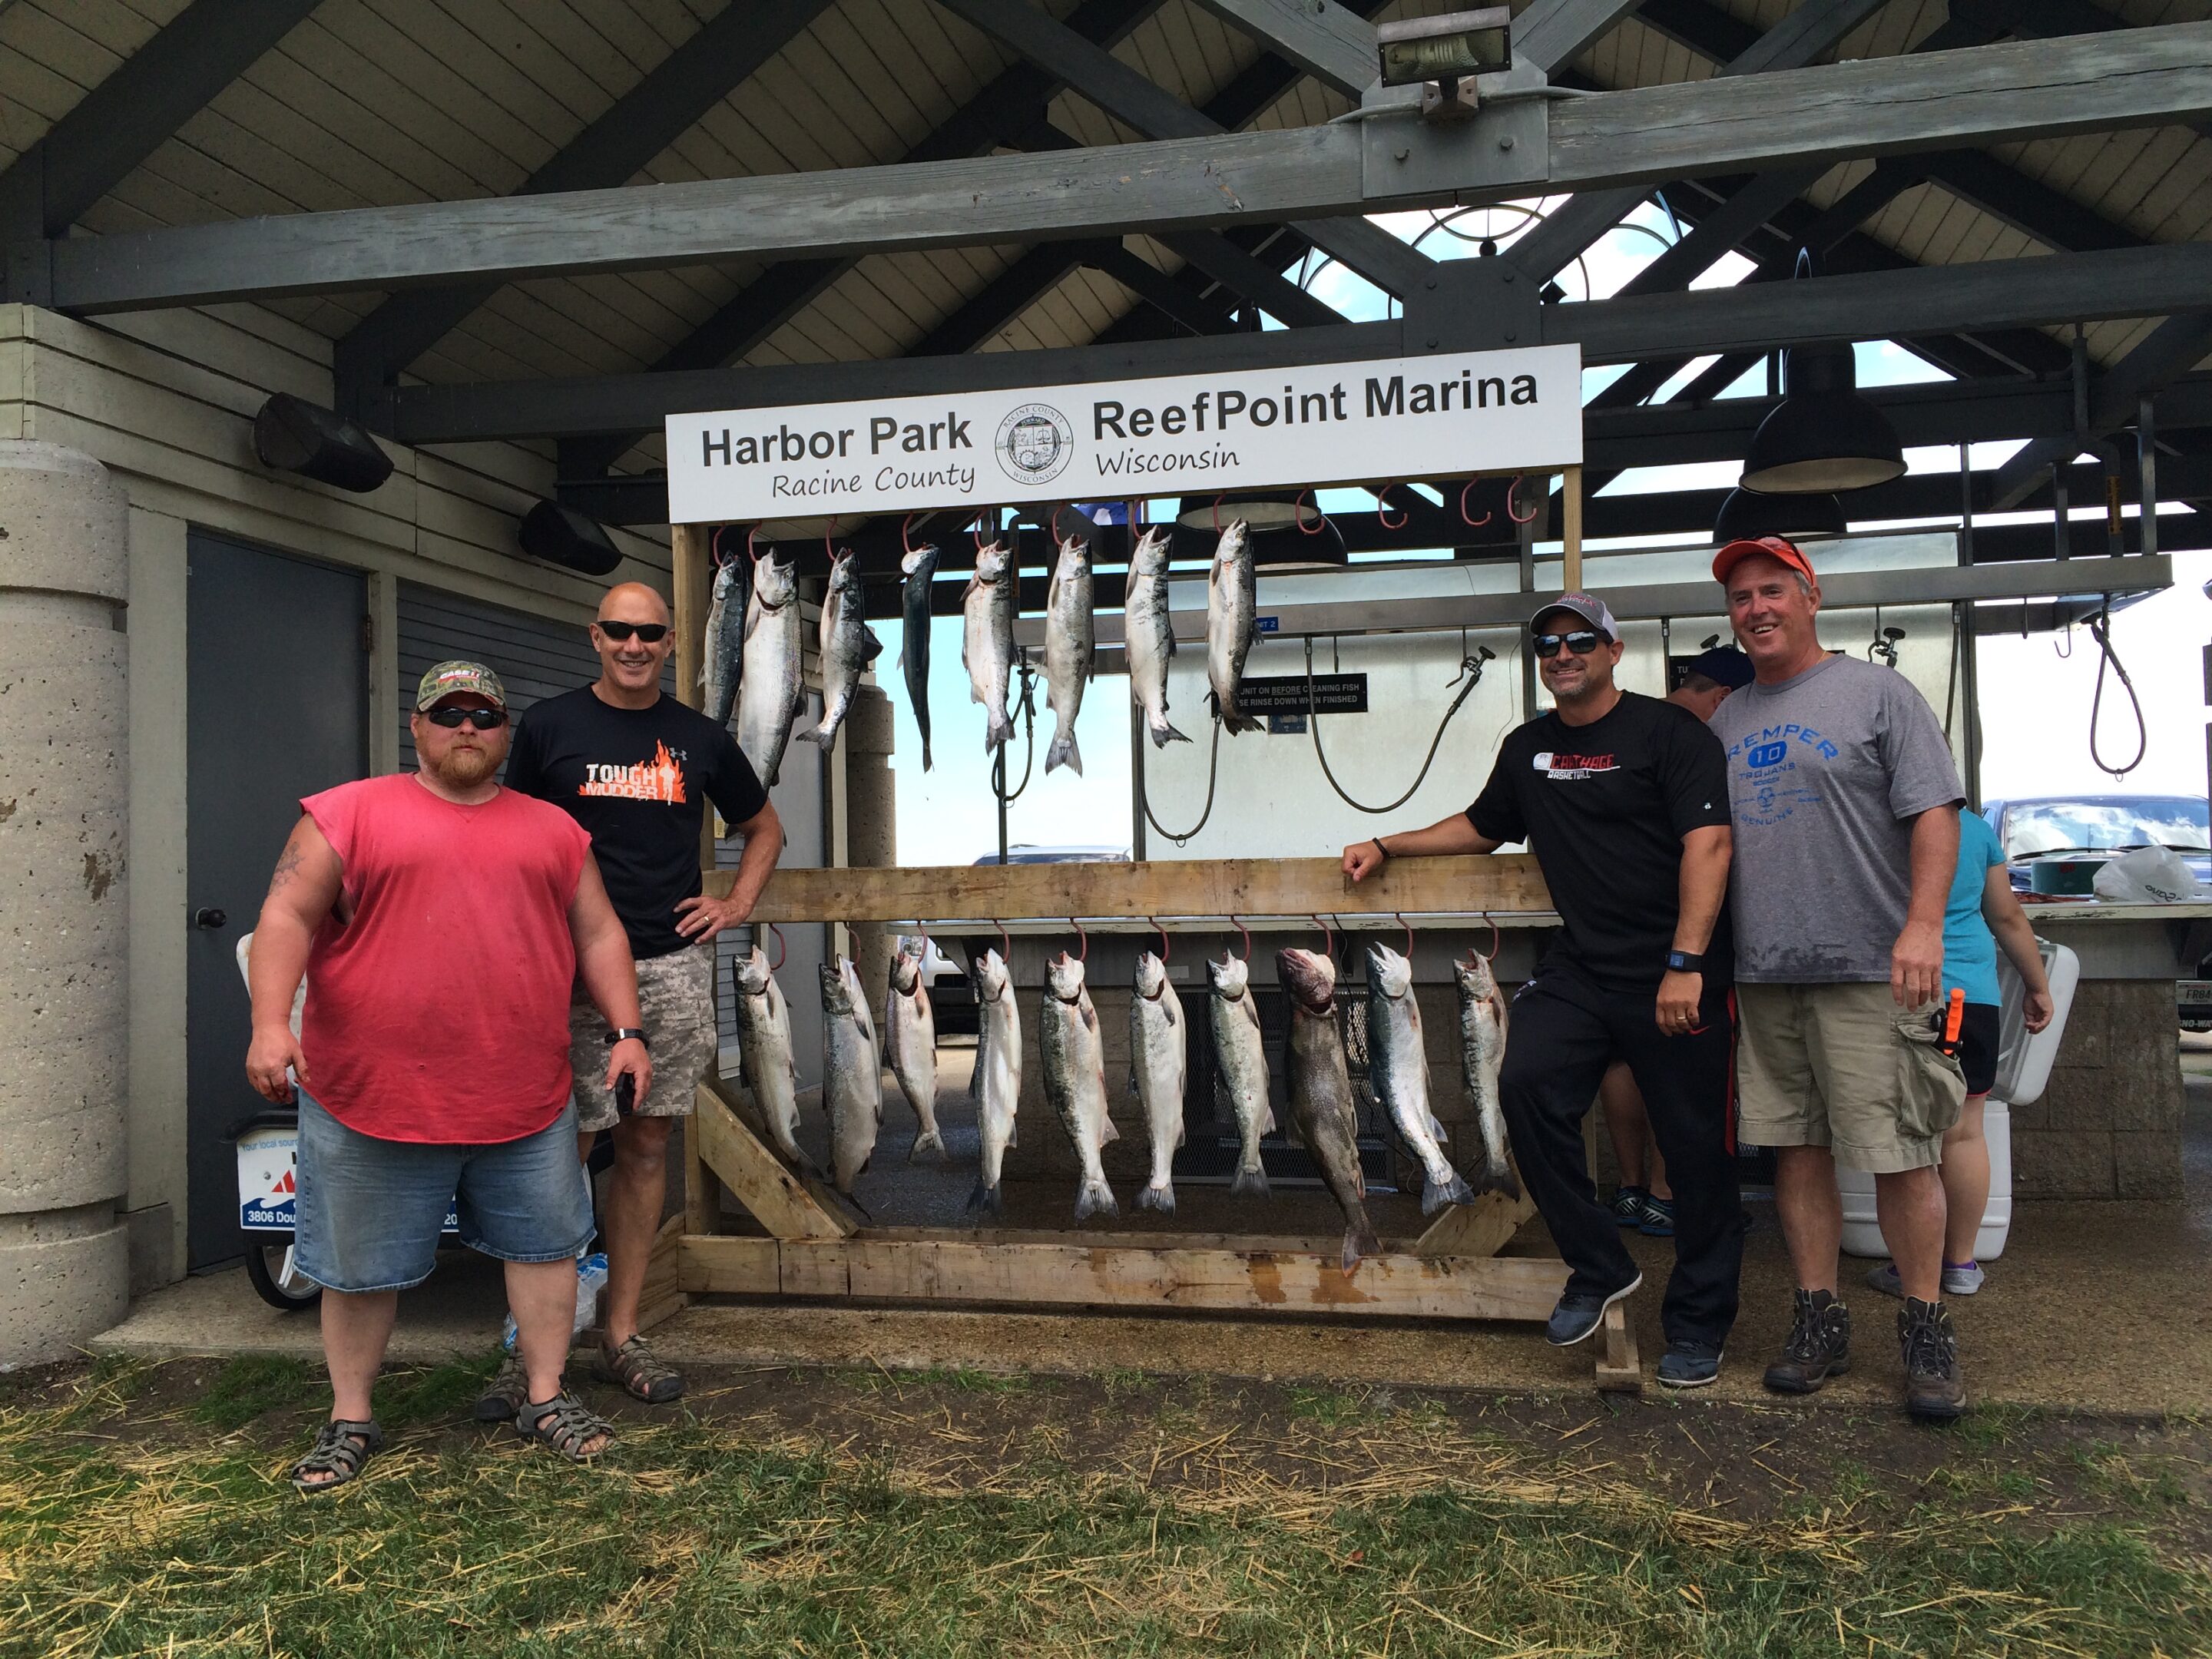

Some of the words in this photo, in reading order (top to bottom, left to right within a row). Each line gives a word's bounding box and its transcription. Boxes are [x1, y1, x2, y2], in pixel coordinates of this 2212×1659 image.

[1092, 382, 1348, 441] ReefPoint
[1365, 369, 1538, 418] Marina
[1004, 408, 1029, 428] RACINE
[1032, 406, 1064, 423] COUNTY
[702, 422, 855, 467] Harbor
[869, 411, 973, 455] Park
[1094, 441, 1241, 477] Wisconsin
[772, 472, 863, 499] Racine
[874, 462, 975, 493] County
[1013, 469, 1058, 482] WISCONSIN
[1258, 686, 1270, 694] ON
[1271, 685, 1301, 695] BEFORE
[1302, 684, 1341, 693] CEANING
[1342, 683, 1359, 691] FISH
[1250, 697, 1273, 706] RINSE
[1274, 697, 1297, 705] DOWN
[1323, 694, 1358, 704] FINISHED
[1551, 753, 1614, 769] CARTHAGE
[1757, 746, 1780, 763] 10
[586, 763, 657, 786] TOUGH
[1738, 763, 1796, 780] TROJANS
[586, 782, 658, 800] MUDDER
[1740, 806, 1793, 825] GENUINE
[241, 1142, 257, 1151] Your
[260, 1139, 277, 1149] local
[247, 1210, 274, 1223] 3806
